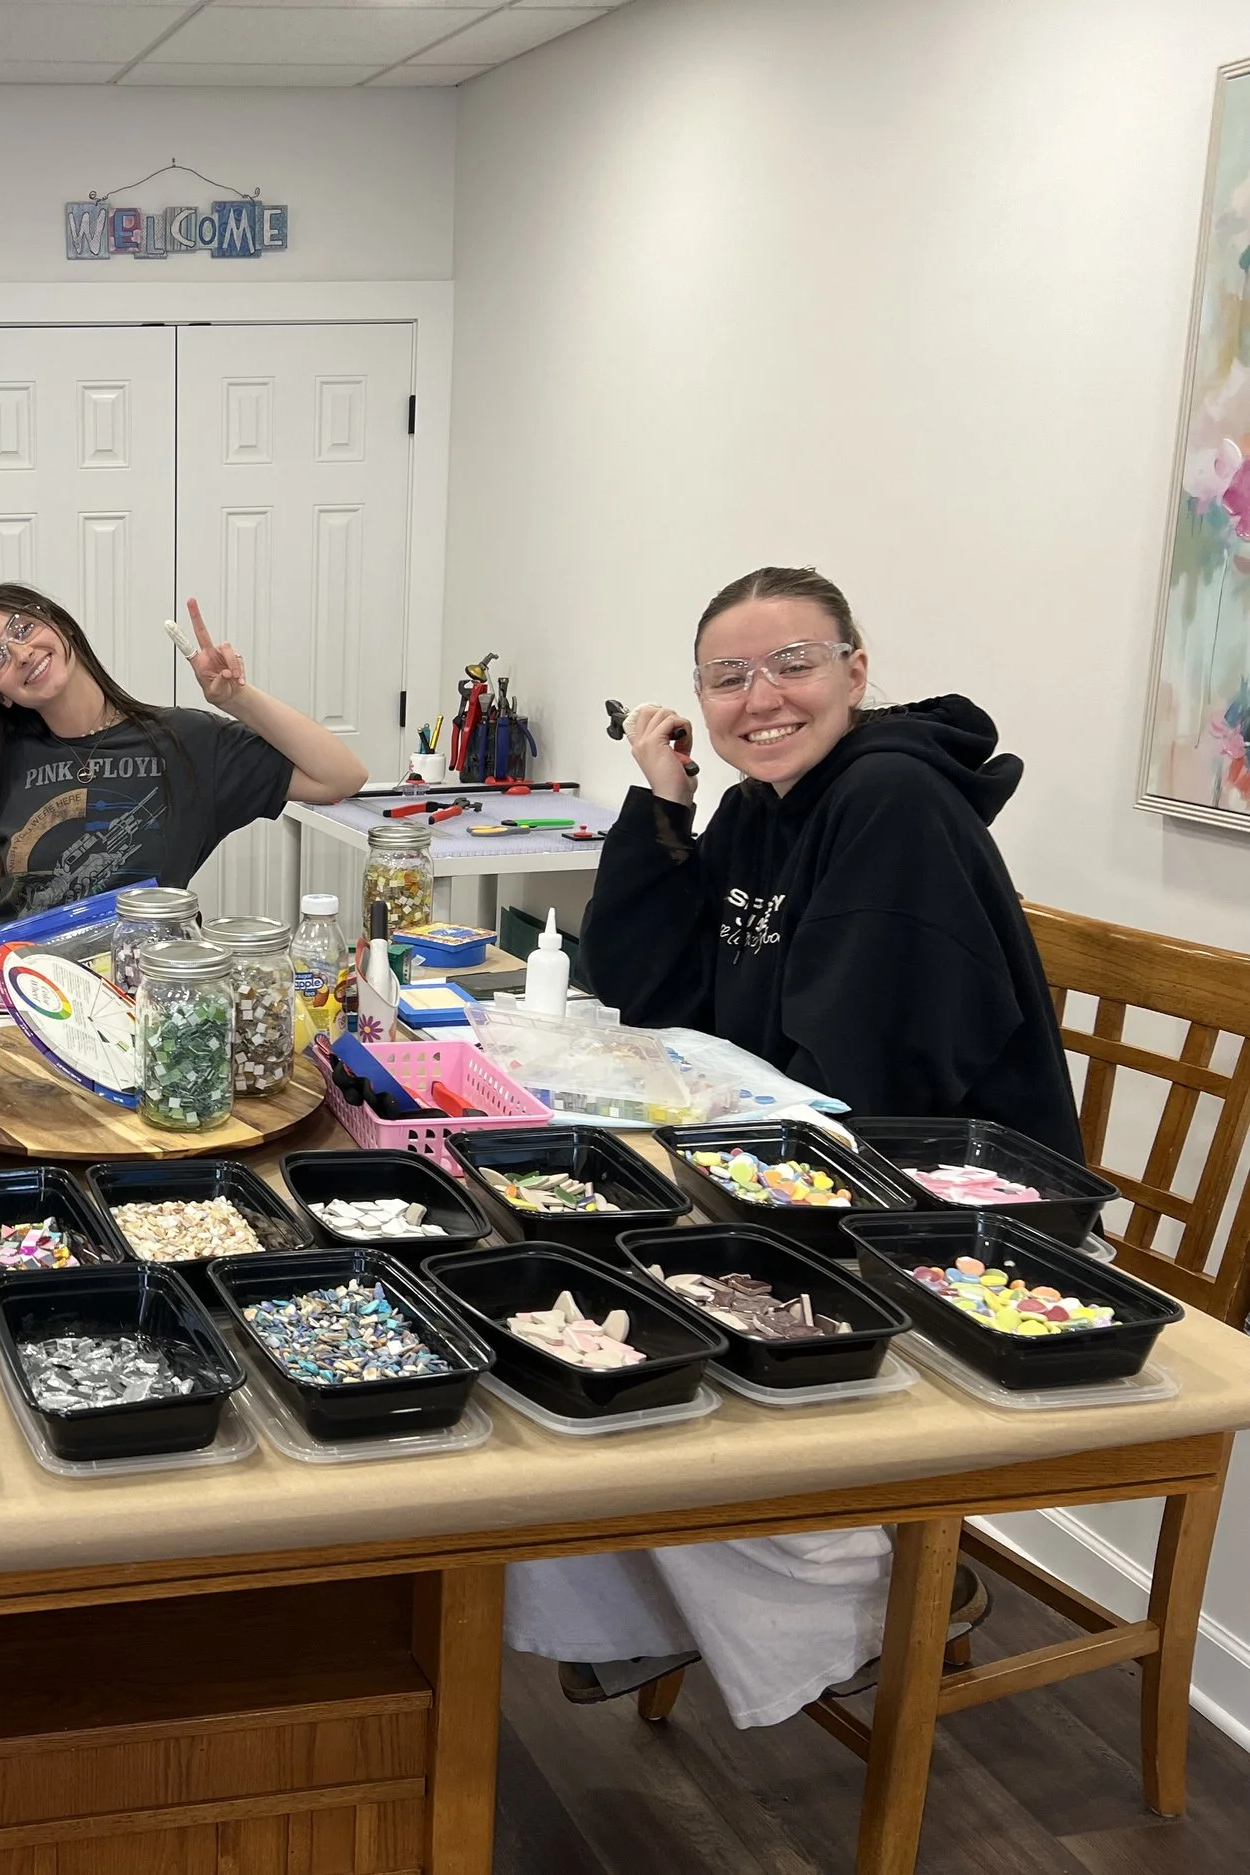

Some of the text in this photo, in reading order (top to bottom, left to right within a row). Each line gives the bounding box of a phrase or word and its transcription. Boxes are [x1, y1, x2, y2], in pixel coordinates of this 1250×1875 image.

[68, 207, 284, 256] WELCOME
[24, 760, 74, 789] PINK
[14, 828, 32, 844] YOU
[31, 805, 56, 827] WERE
[56, 793, 82, 808] HERE
